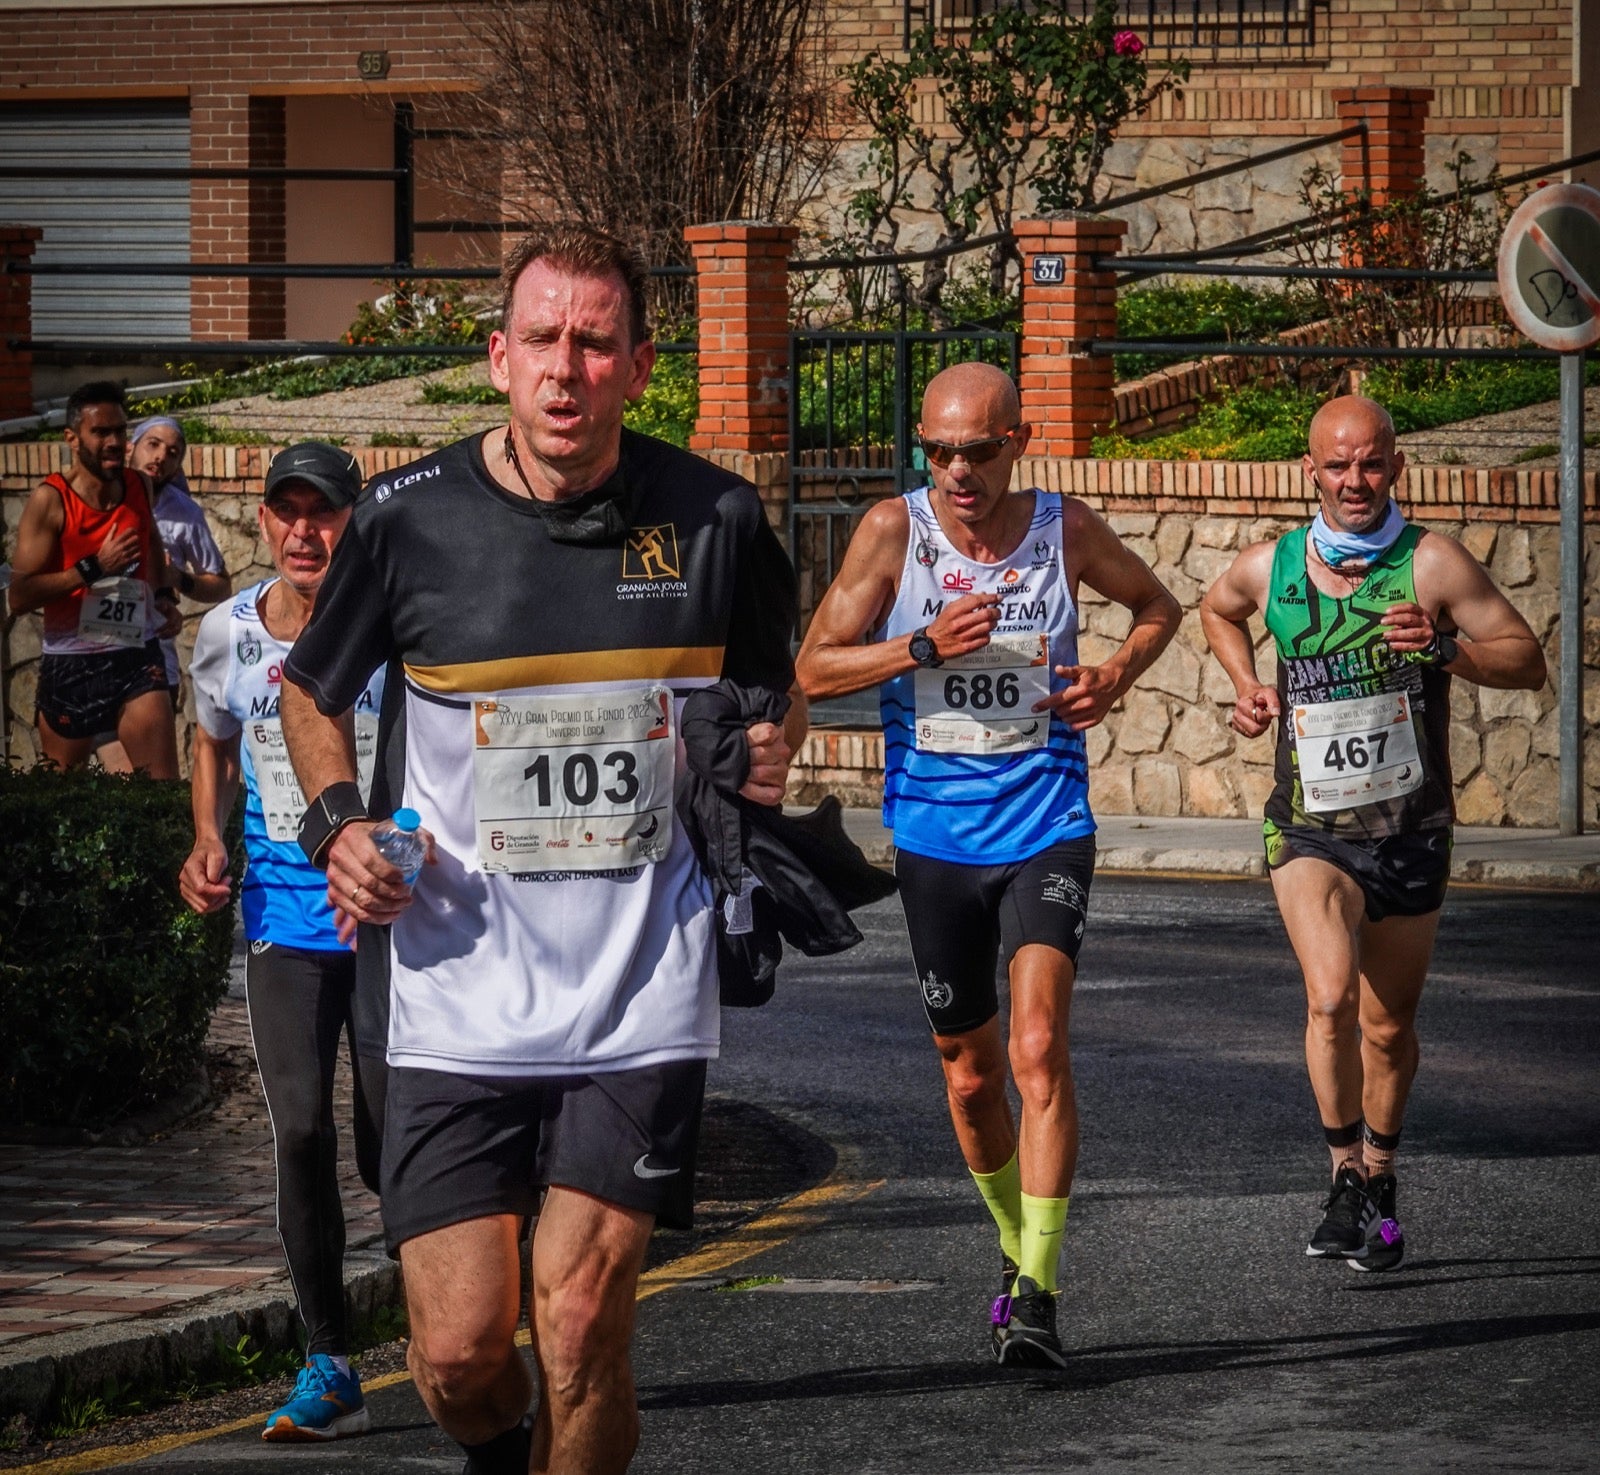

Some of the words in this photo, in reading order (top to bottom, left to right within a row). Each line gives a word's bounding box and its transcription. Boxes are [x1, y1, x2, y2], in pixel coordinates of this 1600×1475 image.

[363, 54, 381, 73] 35
[1039, 260, 1058, 279] 37
[394, 465, 441, 490] Cervi
[616, 583, 660, 593] GRANADA
[661, 582, 687, 593] JOVEN
[1278, 596, 1306, 605] VIATOR
[97, 599, 136, 622] 287
[944, 672, 1020, 709] 686
[1309, 687, 1328, 703] DE
[499, 711, 522, 726] XXXV
[525, 710, 548, 725] GRAN
[551, 711, 581, 723] PREMIO
[584, 710, 594, 723] DE
[597, 707, 625, 722] FONDO
[627, 703, 650, 720] 2022
[546, 726, 581, 738] UNIVERSO
[583, 725, 606, 737] LORCA
[1323, 731, 1389, 772] 467
[272, 770, 284, 786] YO
[524, 750, 640, 807] 103
[514, 840, 540, 848] Granada
[512, 871, 571, 882] PROMOCIÓN
[574, 869, 615, 881] DEPORTE
[618, 866, 638, 878] BASE
